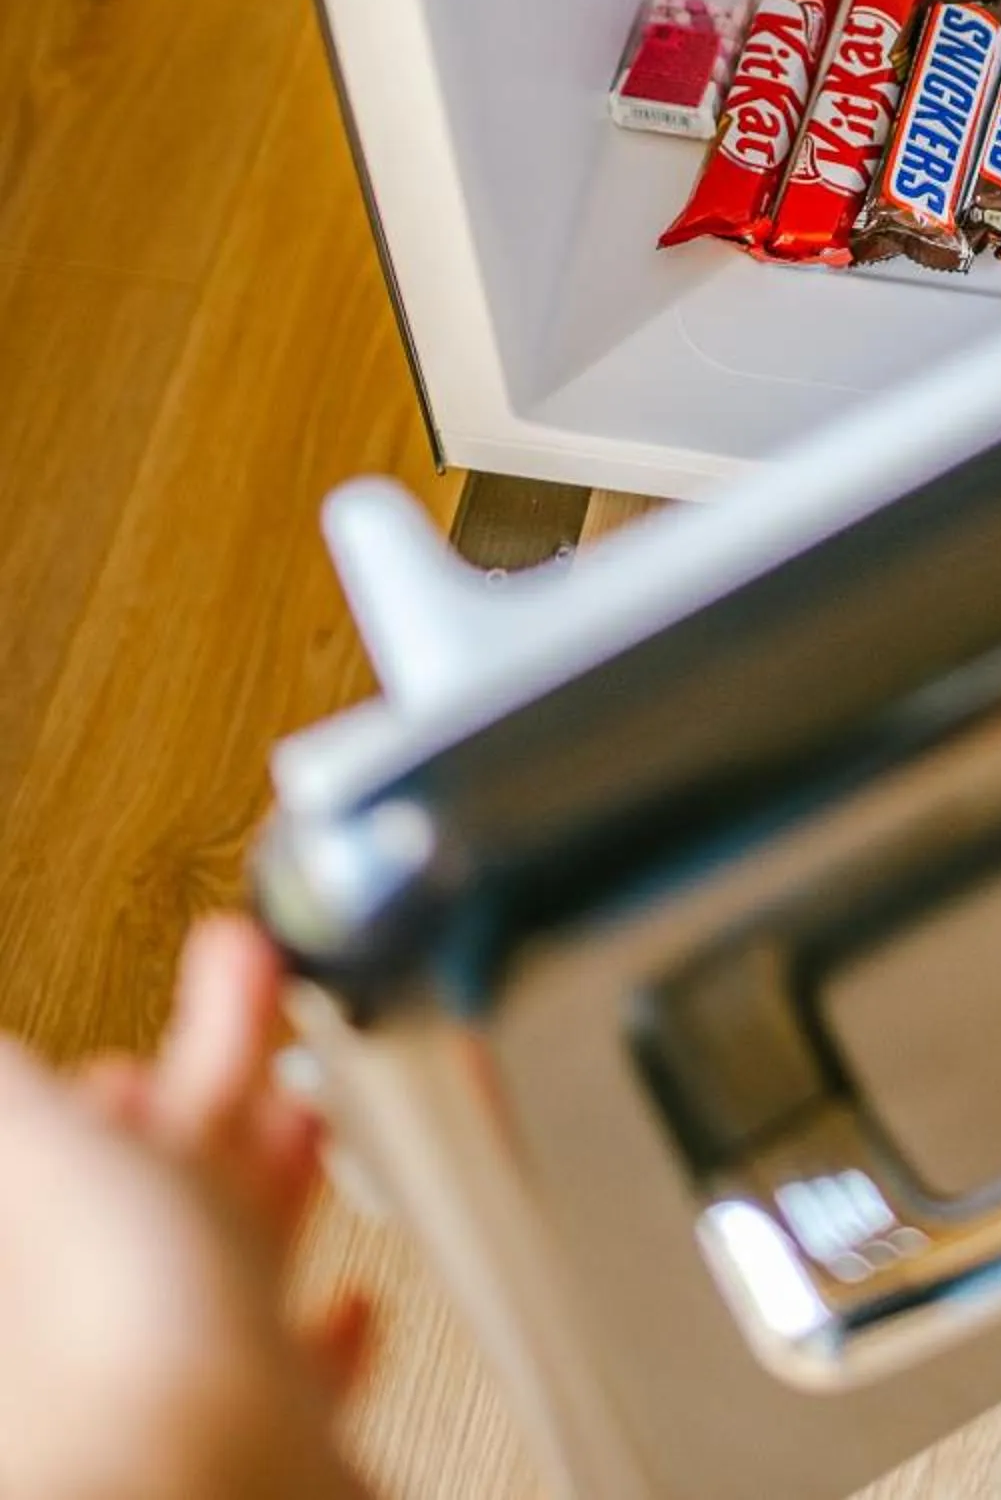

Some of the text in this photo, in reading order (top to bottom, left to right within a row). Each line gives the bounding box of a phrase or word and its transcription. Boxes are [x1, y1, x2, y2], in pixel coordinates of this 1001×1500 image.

[724, 11, 814, 168] KitKat
[804, 6, 899, 169] KitKat
[894, 6, 993, 217] SNICKERS
